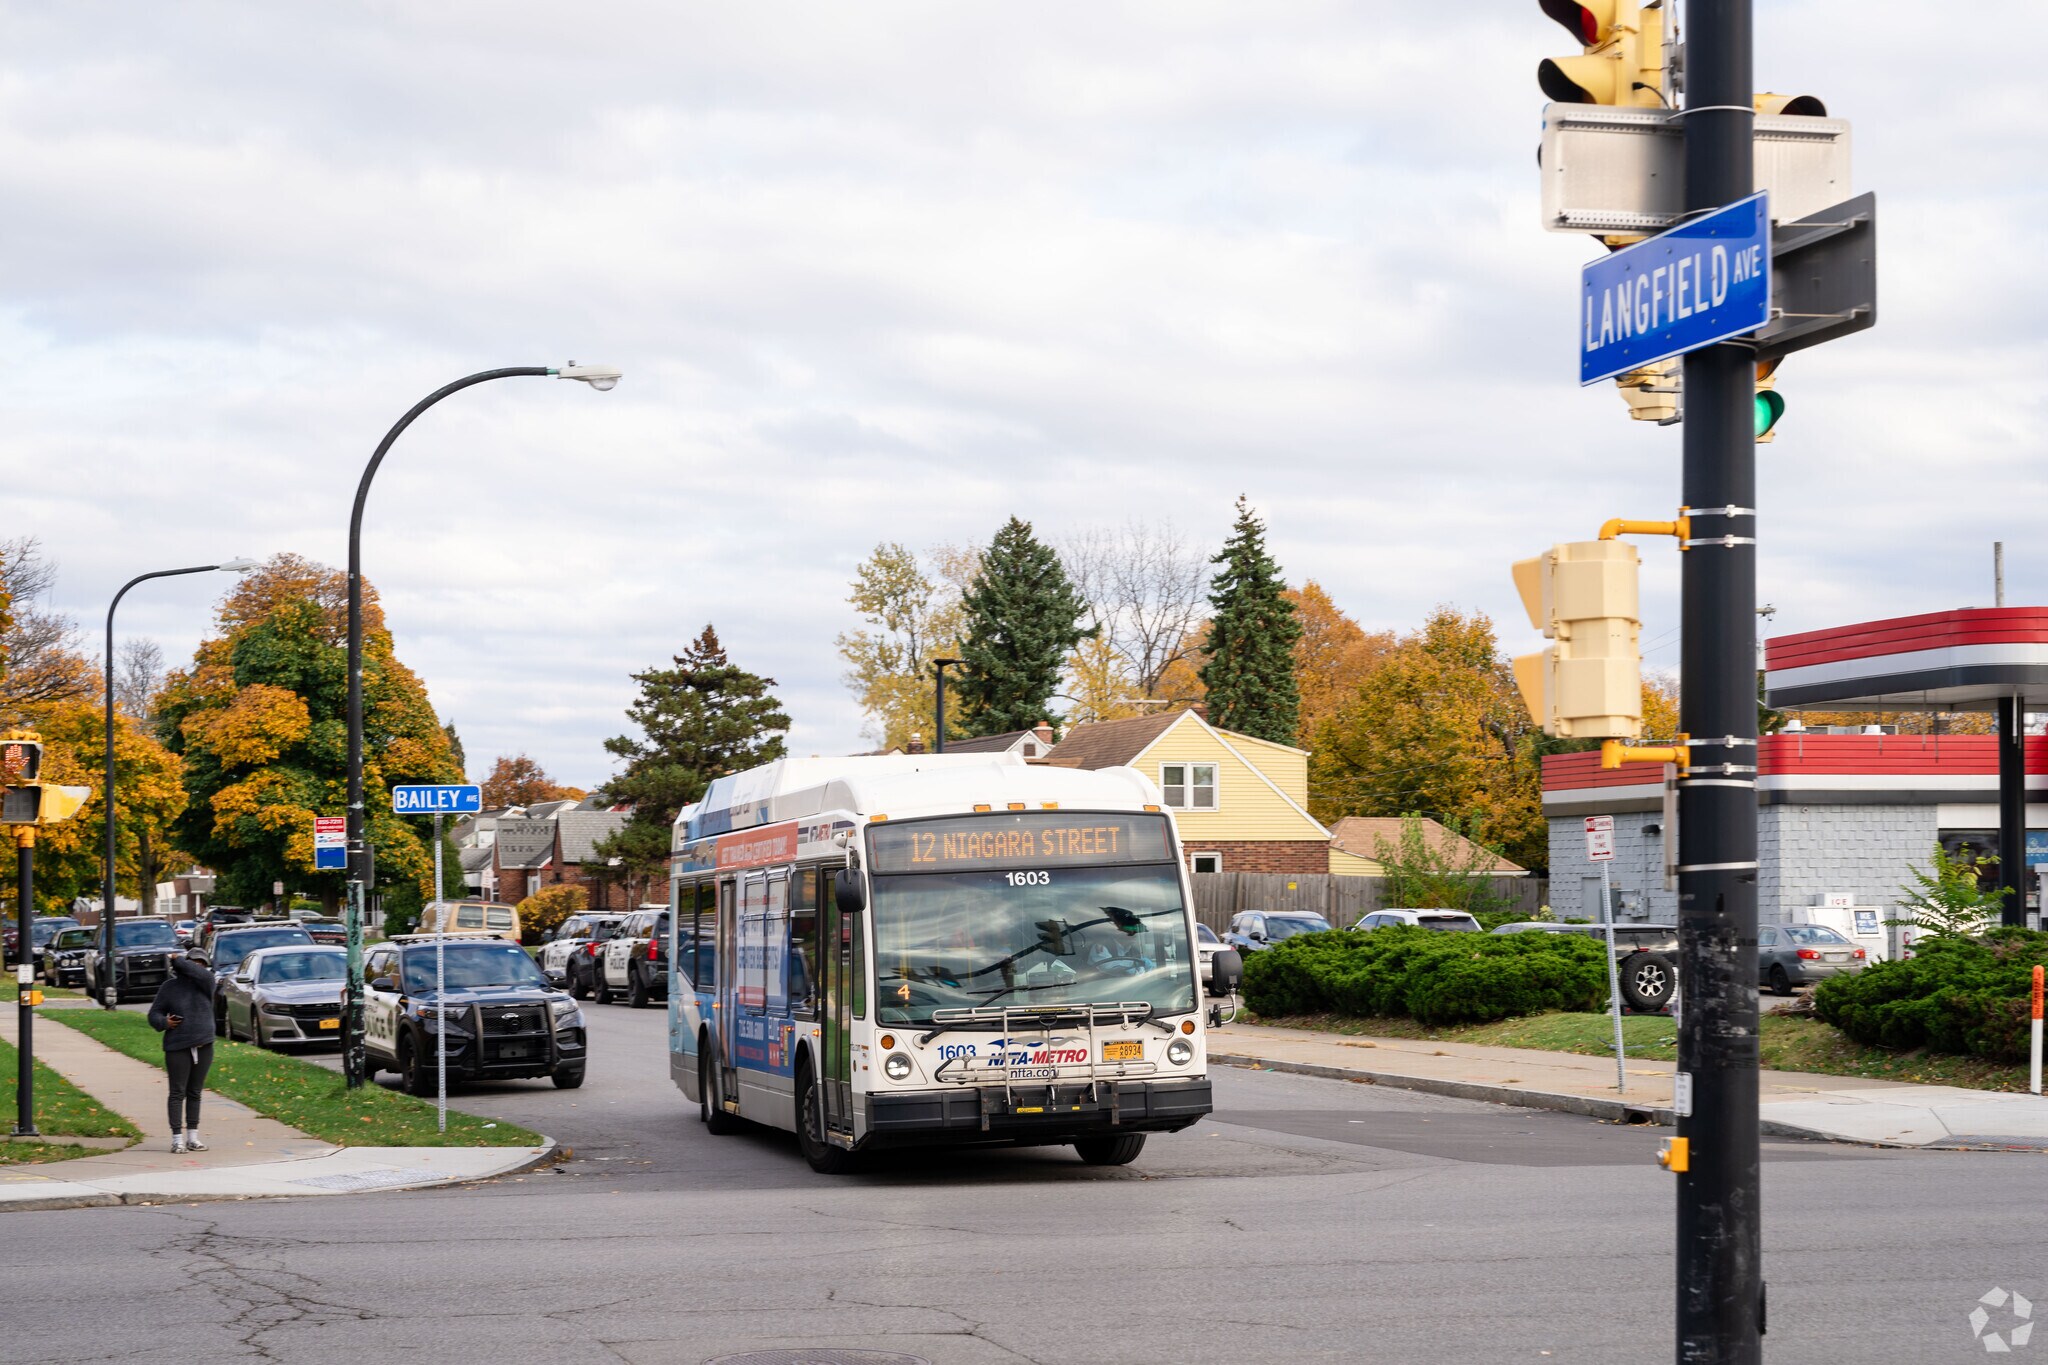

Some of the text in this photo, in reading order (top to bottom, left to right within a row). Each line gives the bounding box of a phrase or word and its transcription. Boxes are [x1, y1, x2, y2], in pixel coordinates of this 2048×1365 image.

[1586, 244, 1761, 352] LANGFIELD AVE
[397, 790, 478, 809] BAILEY AVE
[911, 827, 1120, 862] 12 NIAGARA STREET
[1005, 871, 1050, 886] 1603
[1831, 898, 1848, 906] ICE
[609, 958, 626, 970] POLICE
[897, 984, 911, 1000] 4
[937, 1044, 977, 1060] 1603
